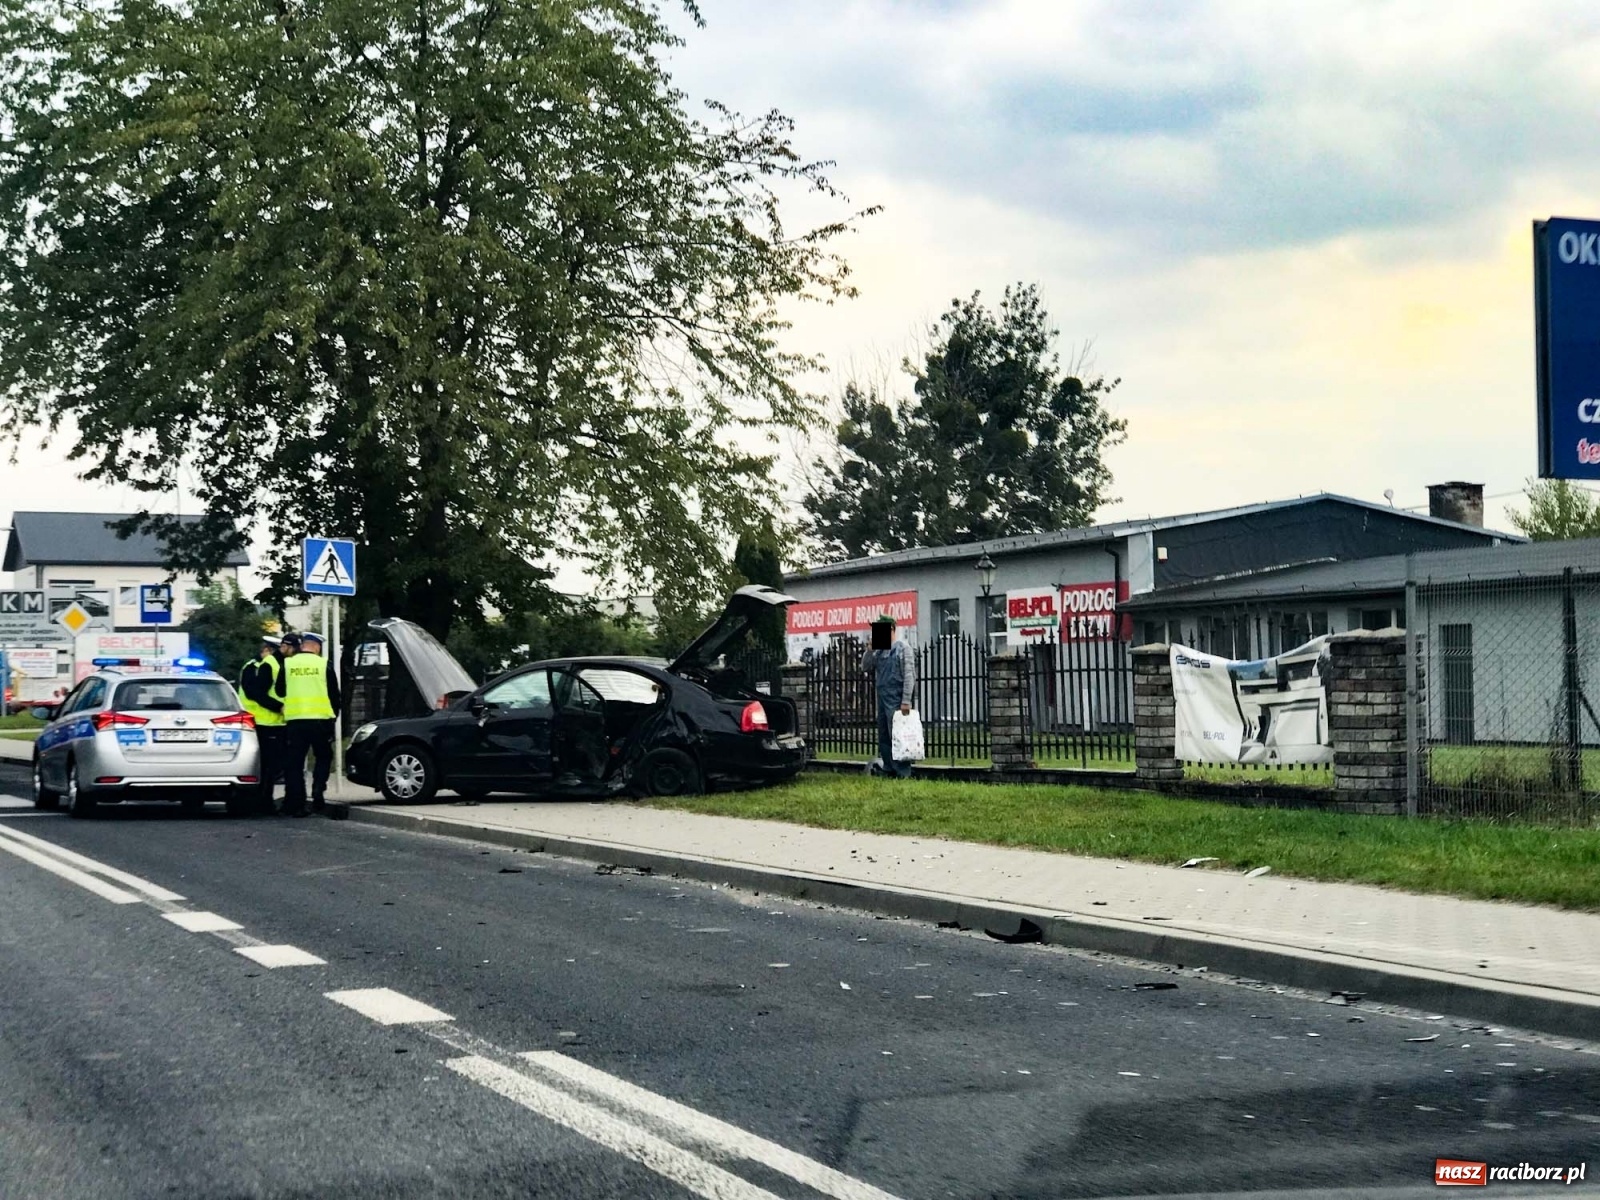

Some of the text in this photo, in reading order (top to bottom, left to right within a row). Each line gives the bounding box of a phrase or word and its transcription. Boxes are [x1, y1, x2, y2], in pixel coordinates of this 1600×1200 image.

[1558, 231, 1600, 266] OK
[1009, 596, 1058, 618] BEL-POL
[1063, 588, 1116, 613] PODŁOGI
[792, 610, 825, 628] PODŁOGI
[827, 607, 853, 626] DRZWI
[888, 601, 913, 620] OKNA
[290, 667, 319, 676] POLICJA
[1203, 730, 1226, 741] BEL-POL
